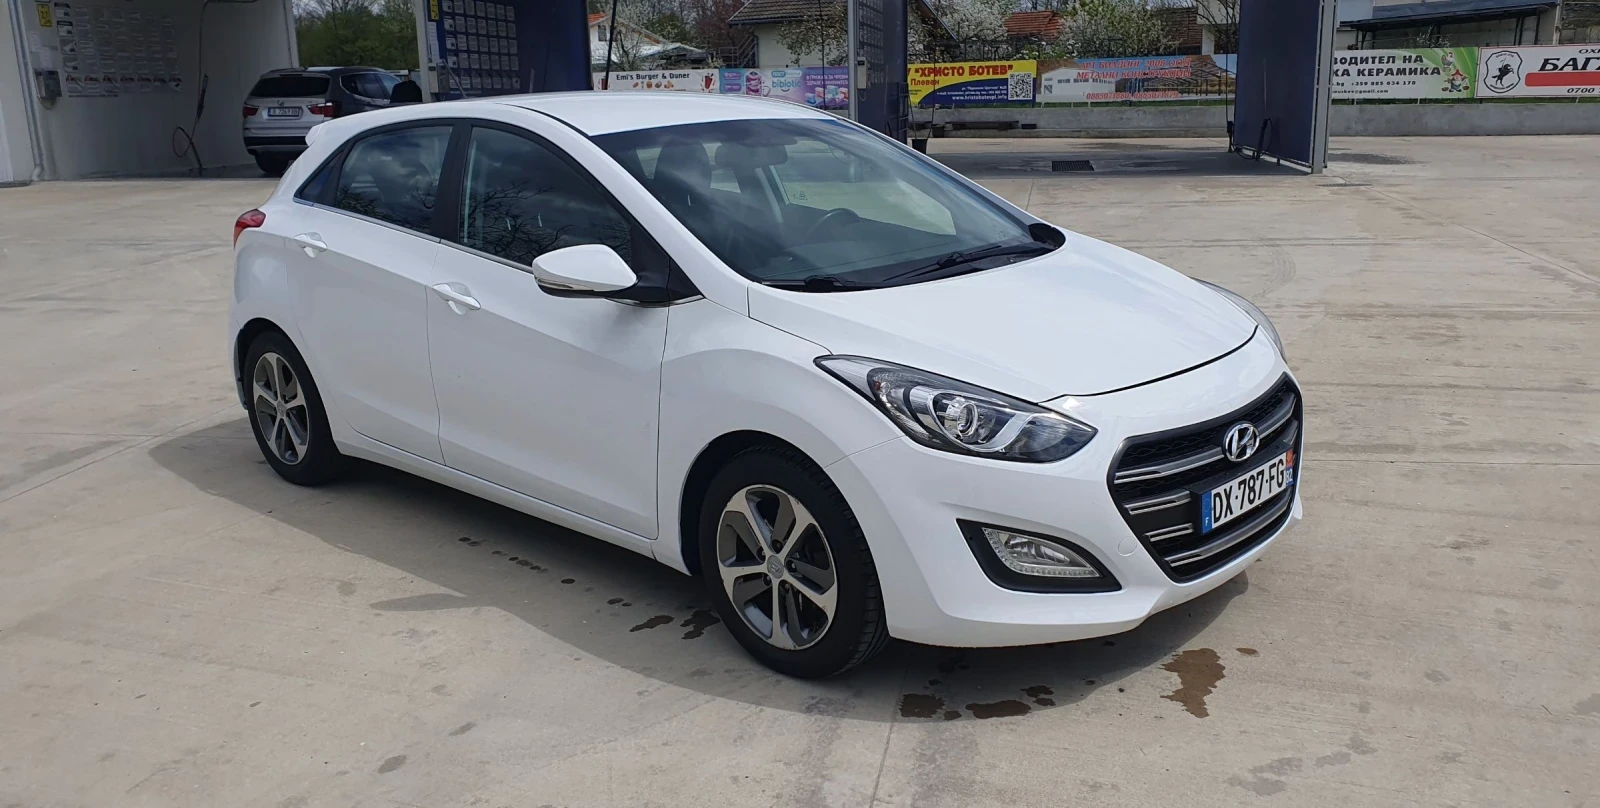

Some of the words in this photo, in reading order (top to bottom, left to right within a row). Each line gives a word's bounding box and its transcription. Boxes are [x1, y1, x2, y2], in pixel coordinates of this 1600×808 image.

[1402, 55, 1423, 63] НА
[1357, 67, 1441, 77] КЕРАМИКА
[636, 73, 659, 81] Burger
